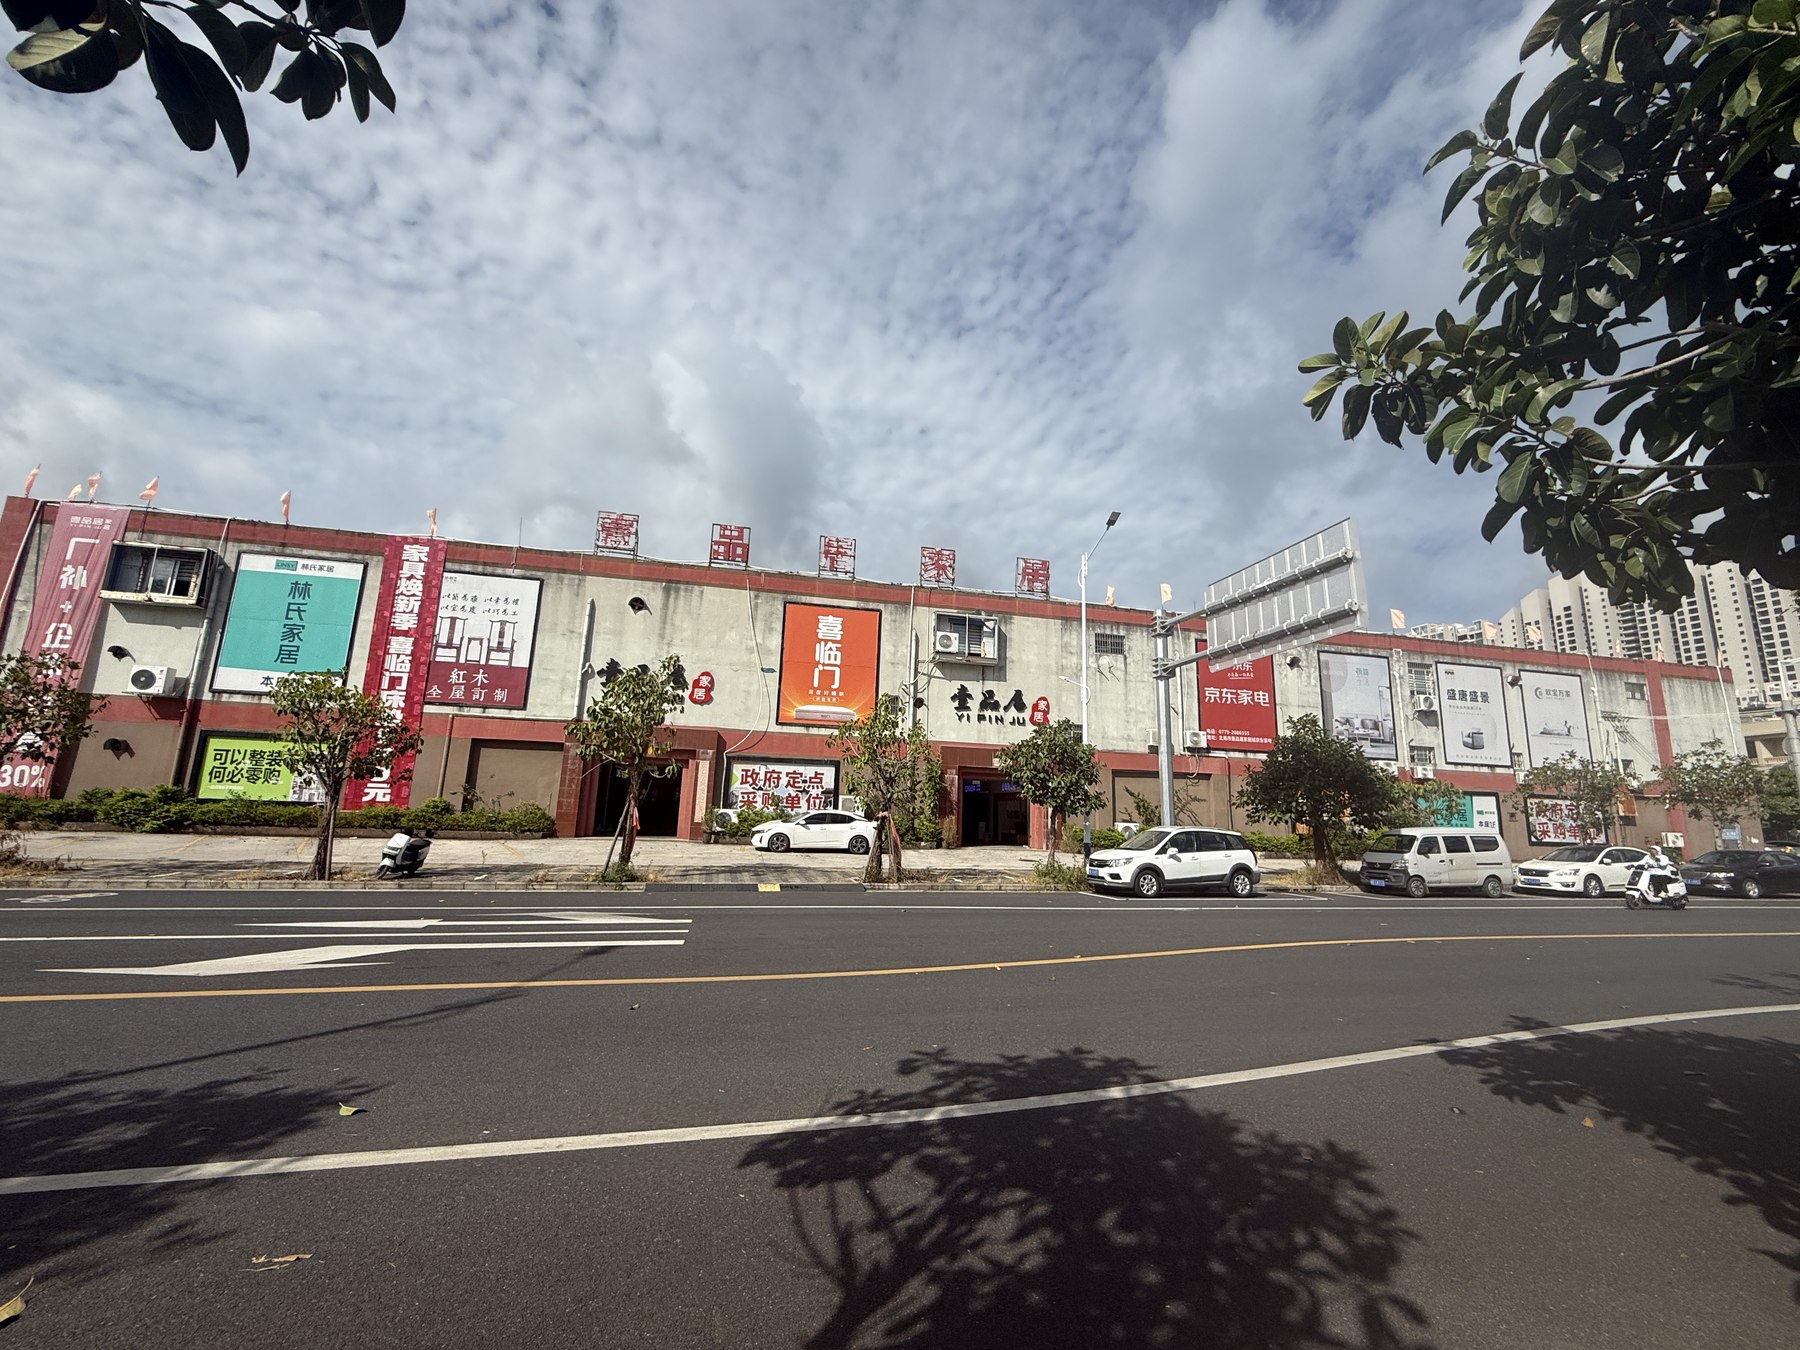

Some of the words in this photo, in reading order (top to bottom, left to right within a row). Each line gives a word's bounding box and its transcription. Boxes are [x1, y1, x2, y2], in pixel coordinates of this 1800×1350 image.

[300, 562, 335, 573] 林氏家居
[390, 544, 430, 631] 家具焕新季
[274, 580, 313, 664] 林氏家居
[813, 614, 844, 689] 喜临门
[448, 668, 490, 687] 紅木
[693, 675, 712, 701] 家居
[426, 685, 508, 703] 全屋訂制
[950, 684, 1027, 713] 壹品居
[1204, 687, 1270, 707] 京东家电
[1447, 688, 1490, 704] 盛唐盛景
[955, 712, 971, 724] YI
[977, 713, 1005, 726] PIN
[1009, 716, 1026, 727] JU
[1033, 699, 1048, 723] 家居
[213, 748, 284, 768] 可以整装
[0, 764, 46, 788] 30%
[208, 766, 281, 785] 何必零购
[740, 768, 825, 790] 政府定点
[738, 790, 825, 812] 采购单位
